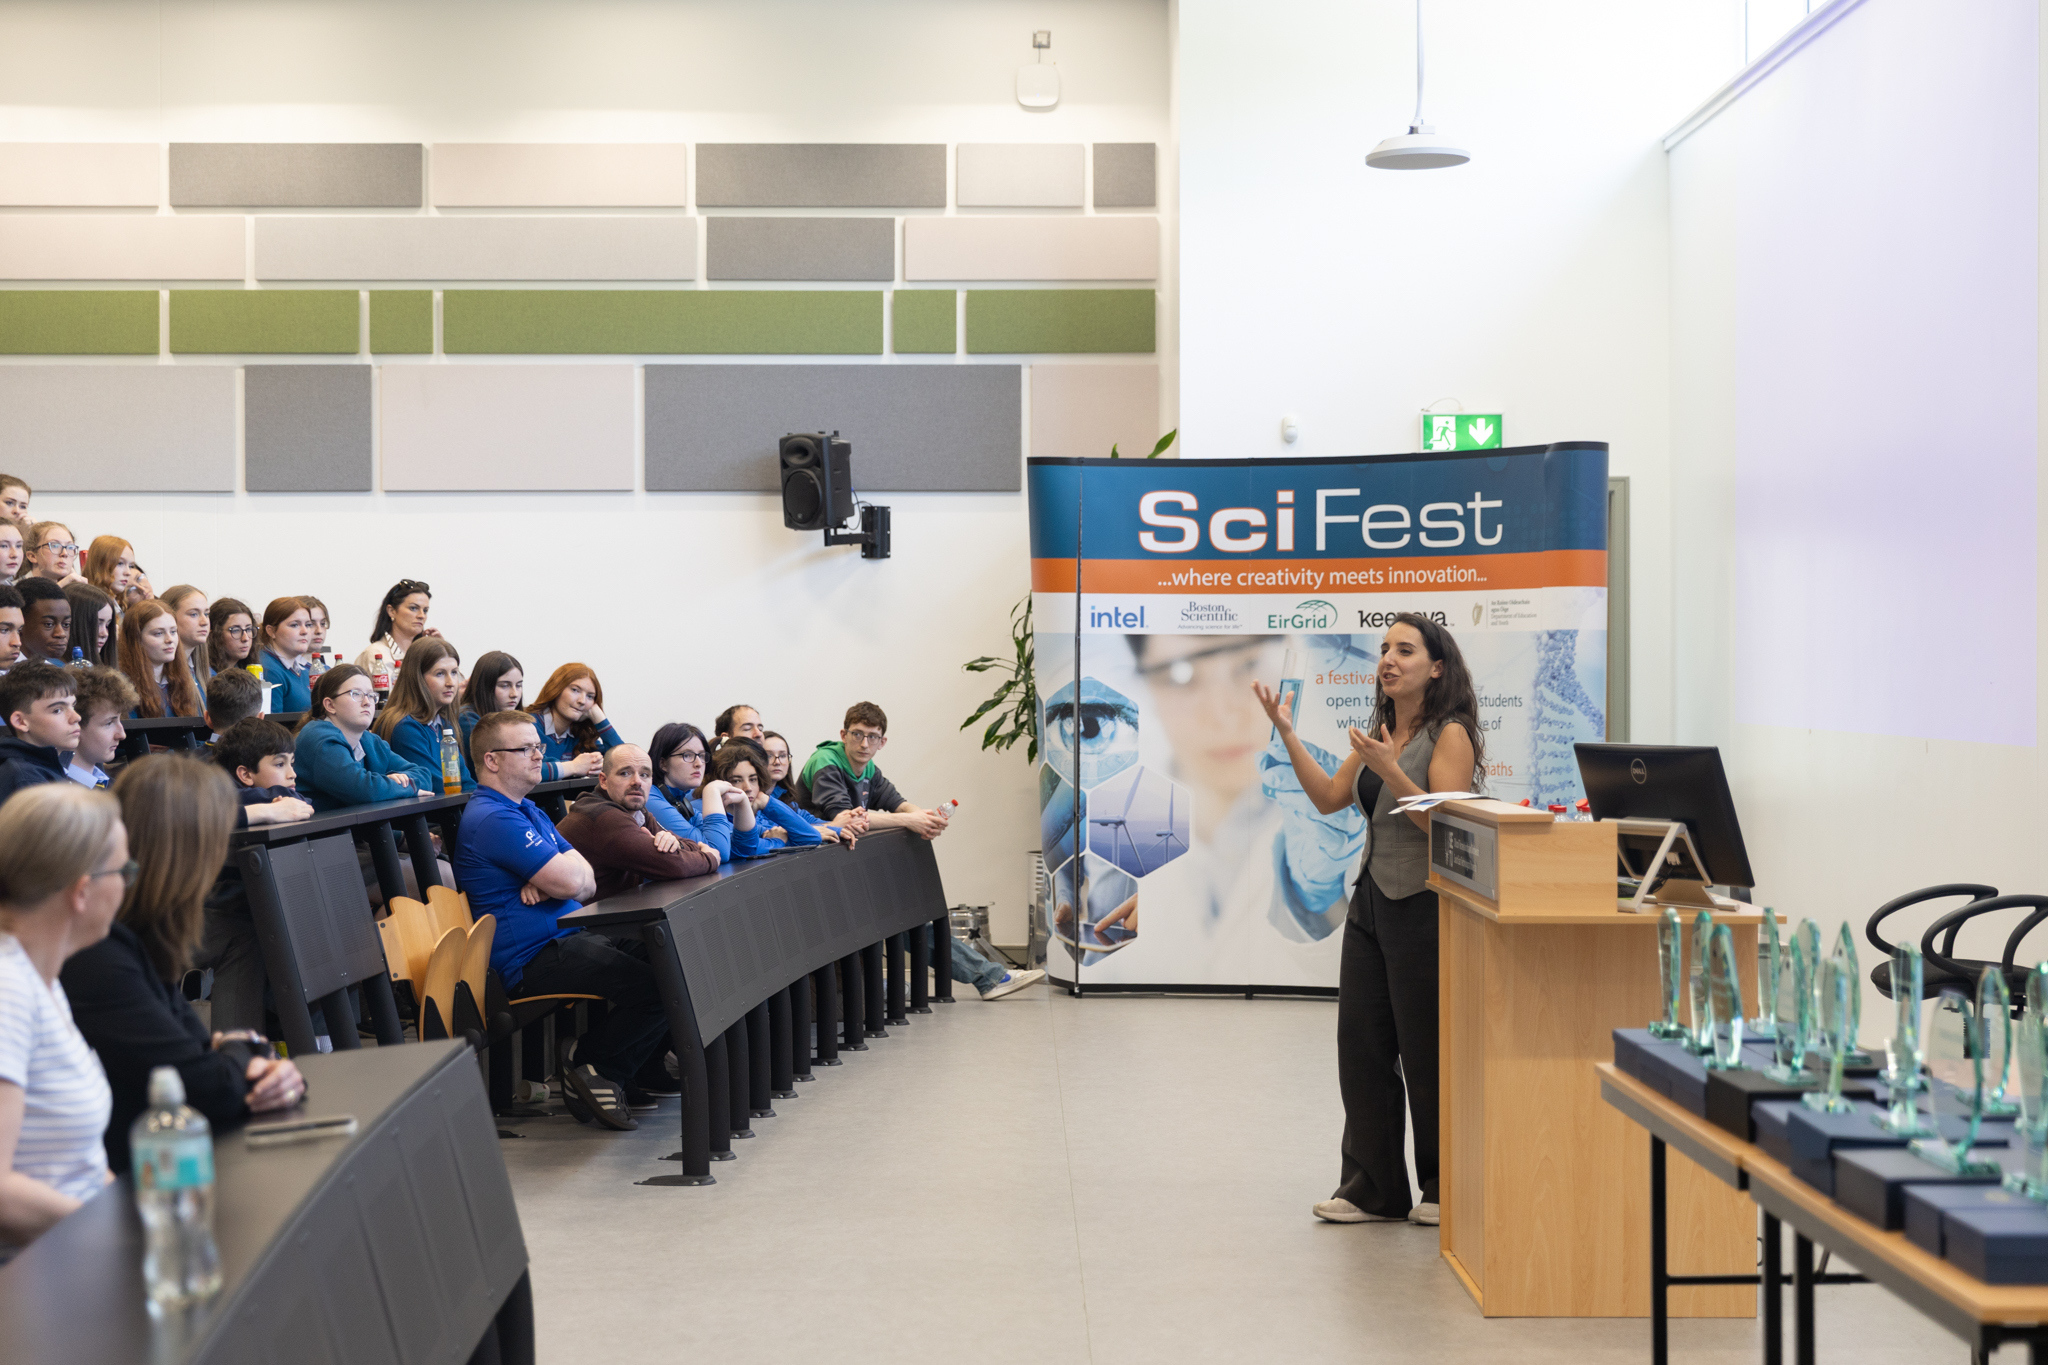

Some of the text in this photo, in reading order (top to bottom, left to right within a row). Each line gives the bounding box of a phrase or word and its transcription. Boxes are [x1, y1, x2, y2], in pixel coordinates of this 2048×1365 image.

[1236, 567, 1325, 591] creativity
[1329, 568, 1384, 585] meets
[1388, 565, 1488, 584] innovation...
[1189, 601, 1225, 612] Boston
[1091, 605, 1145, 628] intel
[1181, 608, 1239, 621] Scientific
[1268, 614, 1327, 629] EirGrid
[1358, 610, 1448, 628] keeva
[1316, 669, 1375, 685] a festiva
[1326, 696, 1361, 710] open
[1479, 693, 1523, 708] students
[1491, 716, 1502, 730] of
